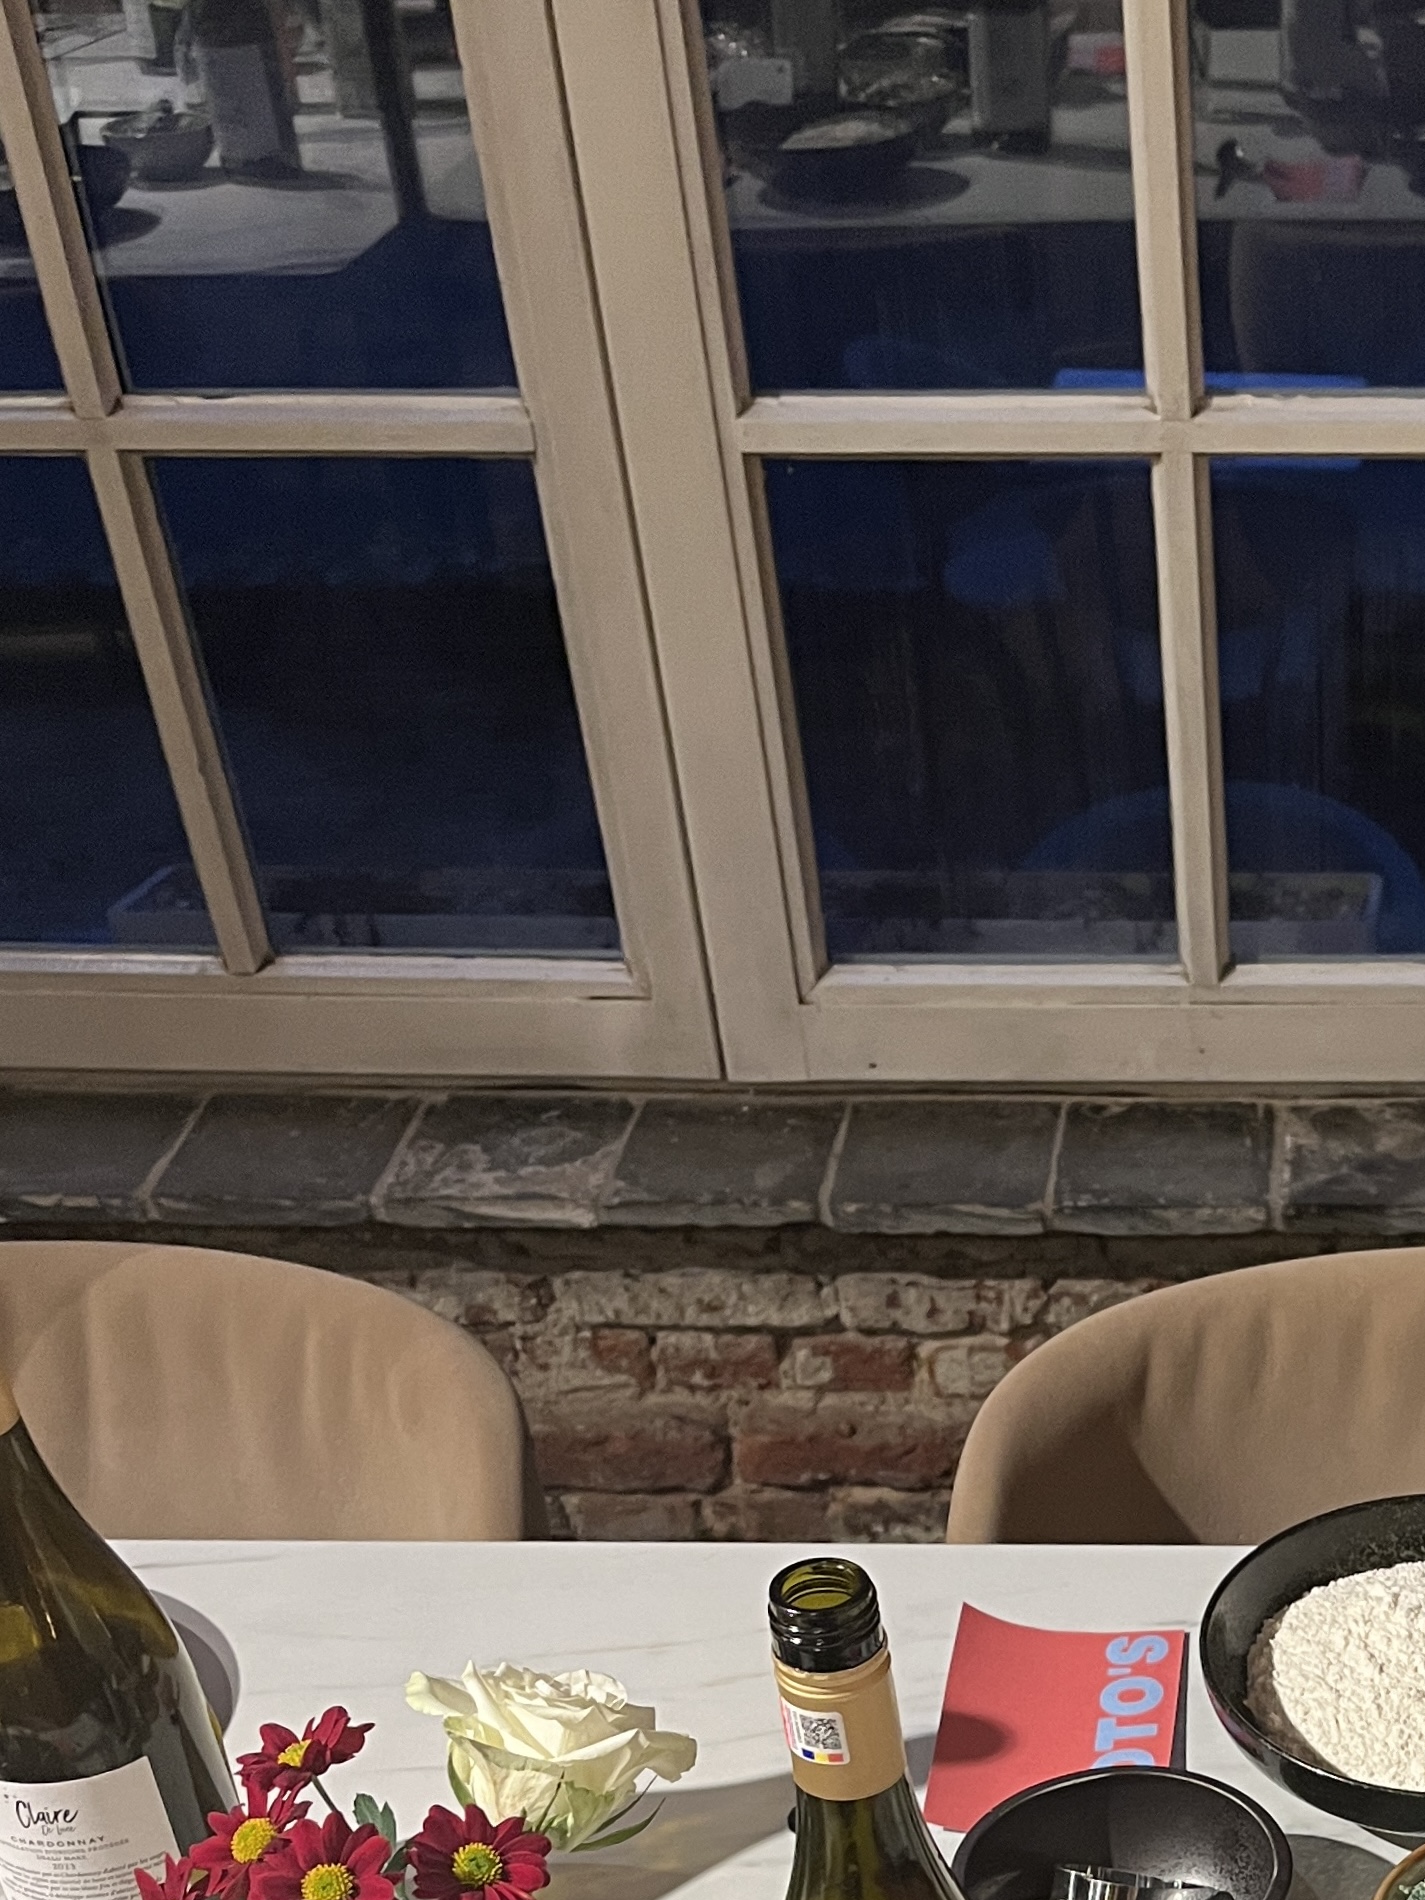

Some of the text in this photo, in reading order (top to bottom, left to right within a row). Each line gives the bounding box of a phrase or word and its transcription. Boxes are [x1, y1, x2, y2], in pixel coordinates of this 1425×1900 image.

[1091, 1634, 1169, 1768] TO'S
[15, 1800, 79, 1829] Claire
[10, 1835, 105, 1848] CHARDONNAY
